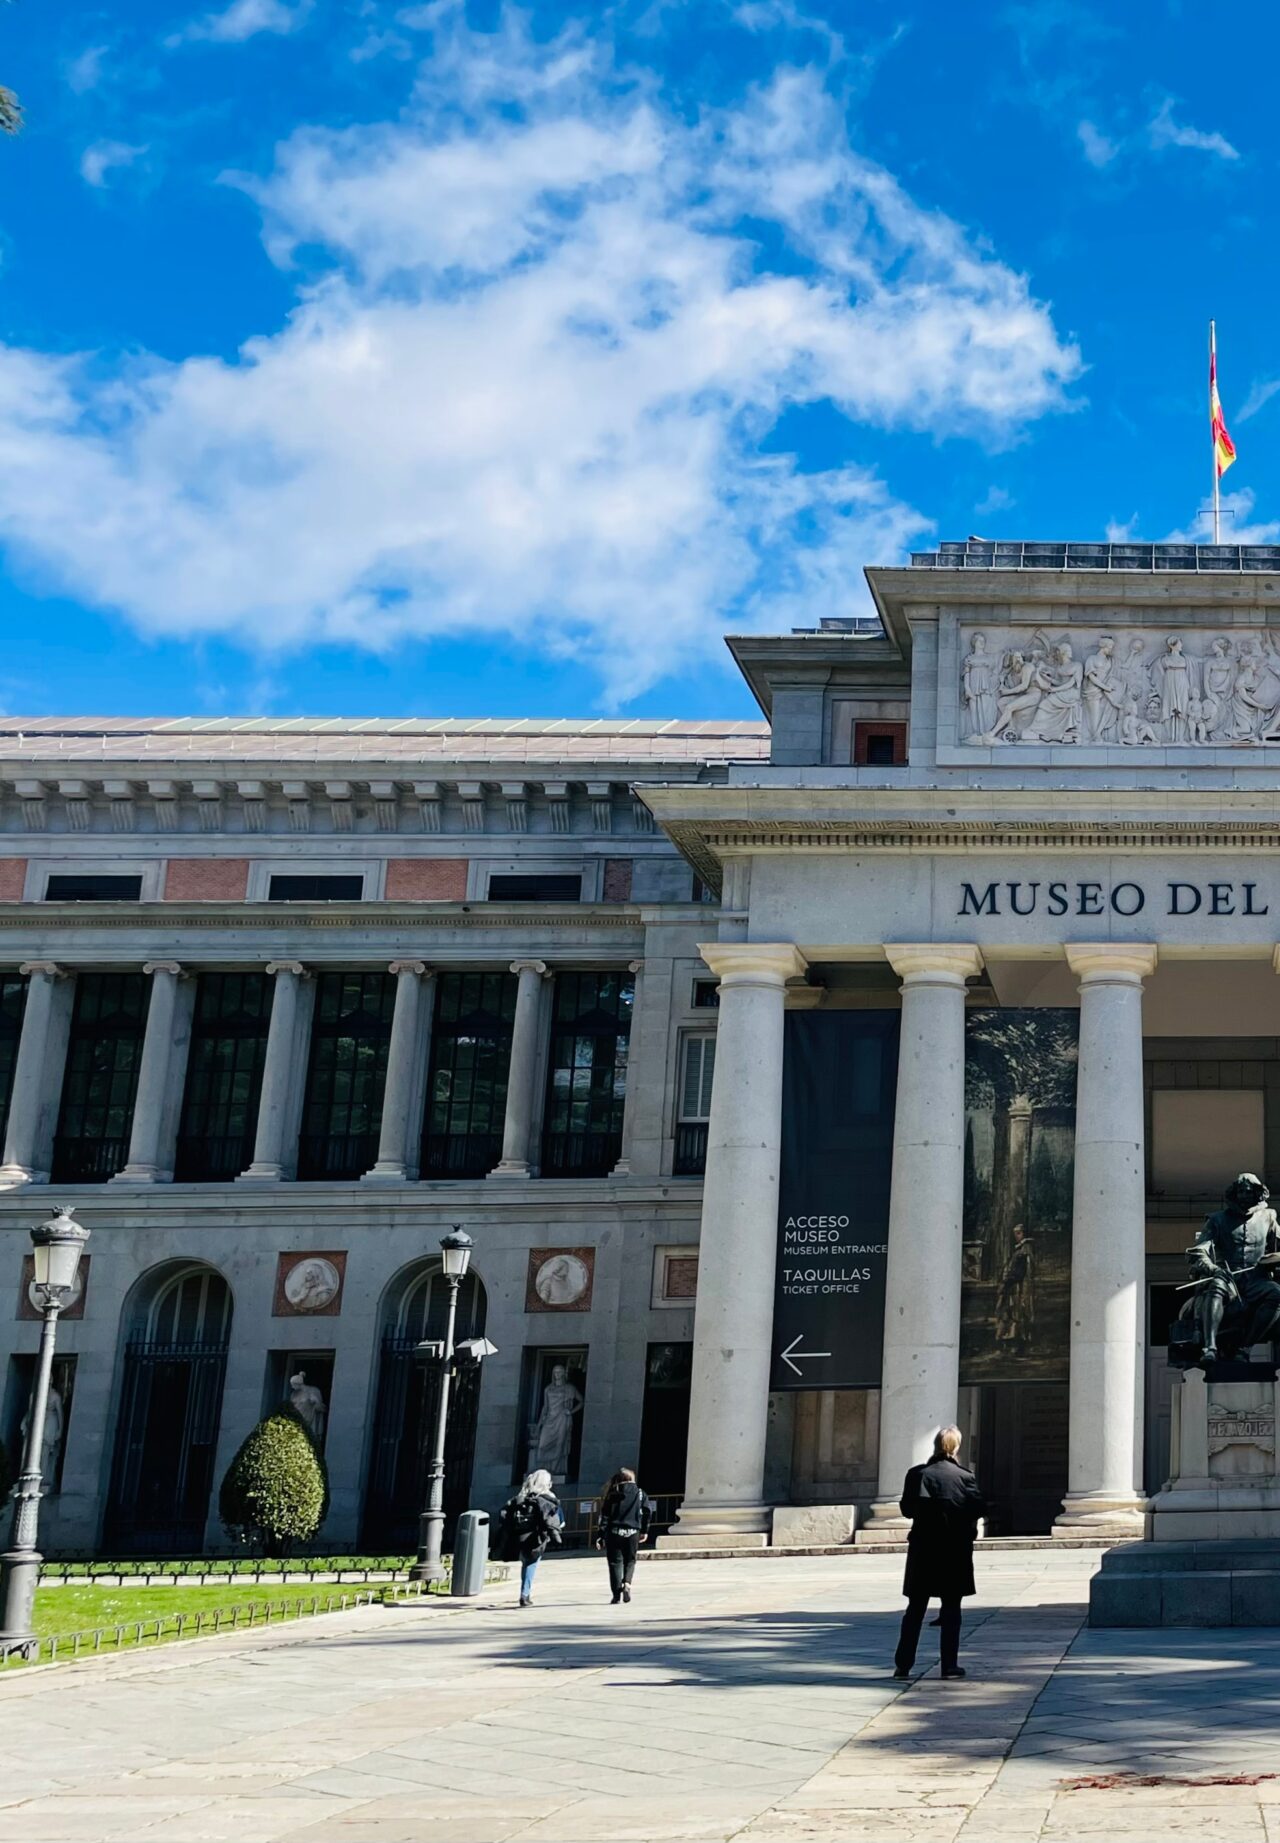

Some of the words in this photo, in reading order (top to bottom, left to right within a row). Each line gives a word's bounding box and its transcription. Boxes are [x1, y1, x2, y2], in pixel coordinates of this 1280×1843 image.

[957, 882, 1146, 916] MUSEO
[1167, 883, 1268, 916] DEL
[785, 1215, 850, 1229] ACCESO
[785, 1230, 840, 1243] MUSEO
[784, 1246, 829, 1255] MUSEUM
[831, 1244, 887, 1254] ENTRANCE
[783, 1268, 871, 1282] TAQUILLAS
[783, 1285, 818, 1294] TICKET
[821, 1284, 860, 1294] OFFICE
